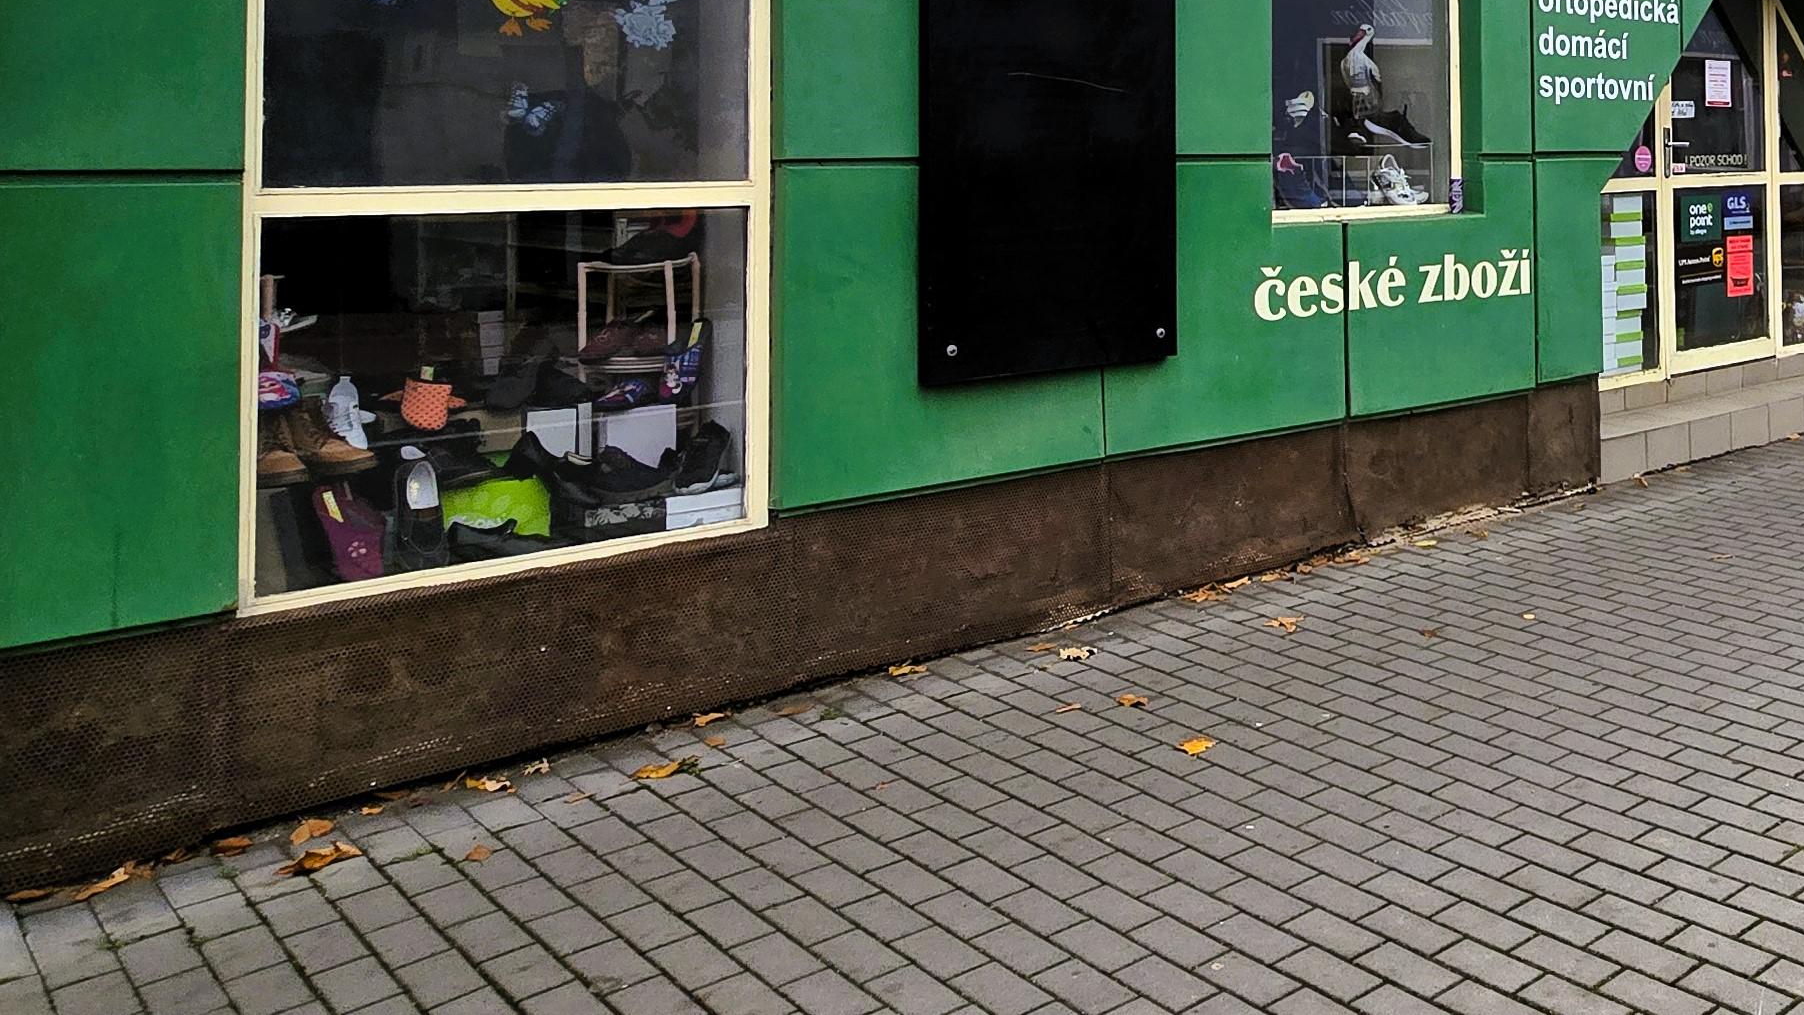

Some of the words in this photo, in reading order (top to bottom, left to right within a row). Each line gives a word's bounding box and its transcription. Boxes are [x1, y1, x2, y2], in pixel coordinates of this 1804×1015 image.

[1538, 26, 1629, 60] domácí
[1539, 72, 1655, 105] sportovní
[1690, 155, 1716, 166] POZOR
[1689, 204, 1707, 215] one
[1727, 196, 1746, 210] GLS
[1689, 214, 1713, 229] point
[1254, 256, 1407, 321] české
[1417, 248, 1532, 304] zboží
